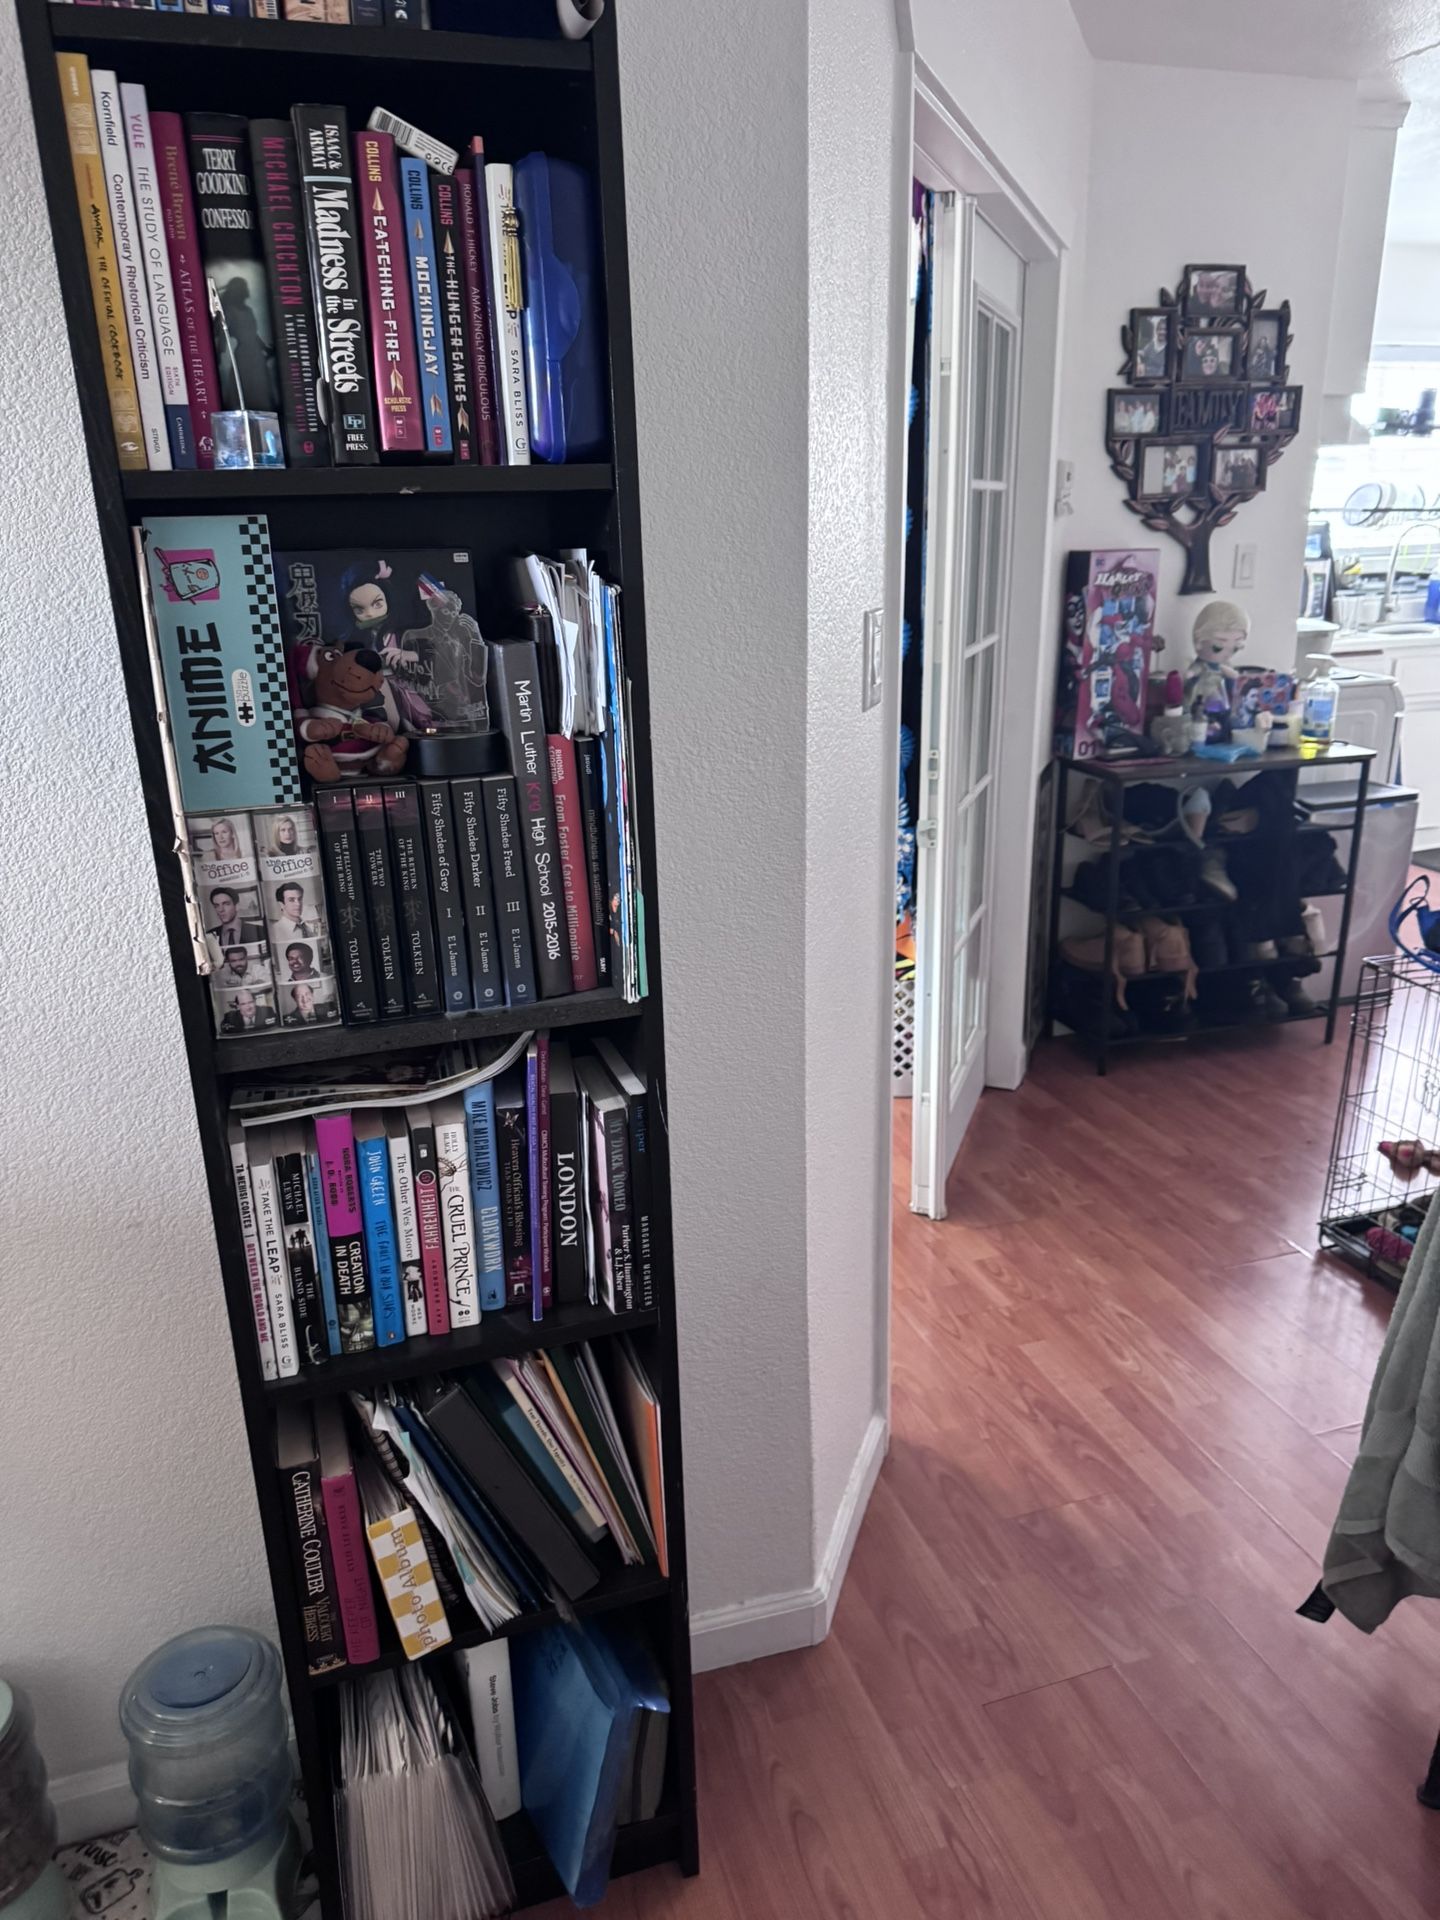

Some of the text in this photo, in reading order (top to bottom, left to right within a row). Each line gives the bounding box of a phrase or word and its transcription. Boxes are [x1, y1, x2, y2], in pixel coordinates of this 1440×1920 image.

[101, 91, 118, 146] Kornfield
[130, 114, 145, 149] YULE
[202, 148, 237, 171] TERRY
[309, 128, 326, 169] ARMAT
[324, 124, 342, 170] ISAAC &
[365, 141, 382, 183] COLLINS
[262, 137, 293, 212] MICHAEL
[408, 170, 424, 211] COLLINS
[173, 192, 187, 240] Brown
[438, 184, 454, 226] COLLINS
[138, 166, 175, 355] THE STUDY OF LANGUAGE
[312, 186, 352, 291] Madness
[112, 174, 149, 380] Contemporary Rhetorical Criticism
[272, 221, 304, 305] CRICHTON
[373, 215, 396, 311] CATCHING
[325, 296, 339, 314] the
[342, 298, 358, 310] in
[415, 256, 439, 375] MOCKINGJAY
[446, 279, 463, 347] HUNGER
[179, 269, 194, 313] ATLAS
[192, 358, 209, 405] HEART
[327, 318, 367, 393] Streets
[384, 320, 401, 361] FIRE
[471, 287, 491, 421] AMAZINGLY RIDICULOUS
[452, 351, 468, 402] GAMES
[511, 350, 523, 427] SARA BLISS
[1173, 388, 1245, 429] FAMILY
[151, 427, 160, 454] STRATA
[346, 433, 364, 442] FREE
[346, 442, 369, 451] PRESS
[1094, 572, 1143, 587] HARLEY
[176, 622, 237, 775] ANIME
[240, 671, 251, 702] puzzle
[514, 680, 532, 723] Martin
[520, 730, 537, 775] Luther
[555, 748, 564, 781] RHONDA
[1078, 741, 1097, 757] 01
[530, 816, 547, 846] High
[554, 795, 566, 823] From
[431, 793, 450, 893] Fifty Shades of Grey
[464, 791, 480, 888] Fifty Shades Darker
[497, 788, 516, 877] Fifty Shades Freed
[557, 825, 570, 862] Foster
[201, 859, 217, 872] the
[208, 860, 249, 879] office
[265, 856, 281, 869] the
[273, 855, 313, 875] office
[342, 848, 354, 900] FELLOWSHIP
[368, 851, 379, 886] TOWERS
[408, 854, 417, 890] RETURN
[535, 852, 552, 897] School
[562, 864, 574, 889] Care
[565, 892, 574, 902] to
[411, 930, 424, 975] TOLKIEN
[543, 902, 561, 960] 2015-2016
[565, 904, 582, 961] Millionaire
[349, 937, 363, 983] TOLKIEN
[381, 935, 394, 980] TOLKIEN
[442, 1131, 450, 1154] BLACK
[450, 1131, 458, 1153] HOLLY
[471, 1100, 493, 1192] MIKE MICHALOWICZ
[609, 1117, 627, 1212] MY DARK ROMEO
[234, 1163, 252, 1229] TA-NEHISI COATES
[283, 1181, 293, 1211] LEWIS
[292, 1171, 303, 1214] MICHAEL
[342, 1147, 356, 1213] NORA ROBERTS
[368, 1150, 386, 1206] JOHN GREEN
[511, 1138, 524, 1248] Heaven Official's Blessing
[557, 1152, 578, 1247] LONDON
[261, 1192, 271, 1215] TAKE
[397, 1153, 414, 1259] The Other Wes Moore
[419, 1188, 440, 1250] FAHRENHEIT
[447, 1194, 465, 1243] CRUEL
[265, 1219, 275, 1236] THE
[375, 1219, 387, 1237] THE
[480, 1206, 502, 1273] CLOCKWORK
[641, 1215, 650, 1259] MARGARET
[266, 1239, 279, 1274] LEAP
[335, 1245, 351, 1295] IN DEATH
[348, 1240, 365, 1295] CREATION
[378, 1240, 390, 1264] FAULT
[379, 1265, 391, 1277] IN
[452, 1241, 471, 1297] PRINCE
[246, 1242, 269, 1343] BETWEEN THE WORLD AND ME
[274, 1292, 285, 1318] SARA
[294, 1266, 307, 1318] BLIND SIDE
[305, 1282, 315, 1299] THE
[382, 1292, 395, 1320] STARS
[278, 1321, 289, 1349] BLISS
[292, 1471, 325, 1596] CATHERINE COULTER
[390, 1527, 439, 1650] photo Album
[317, 1595, 333, 1642] VALCOURT
